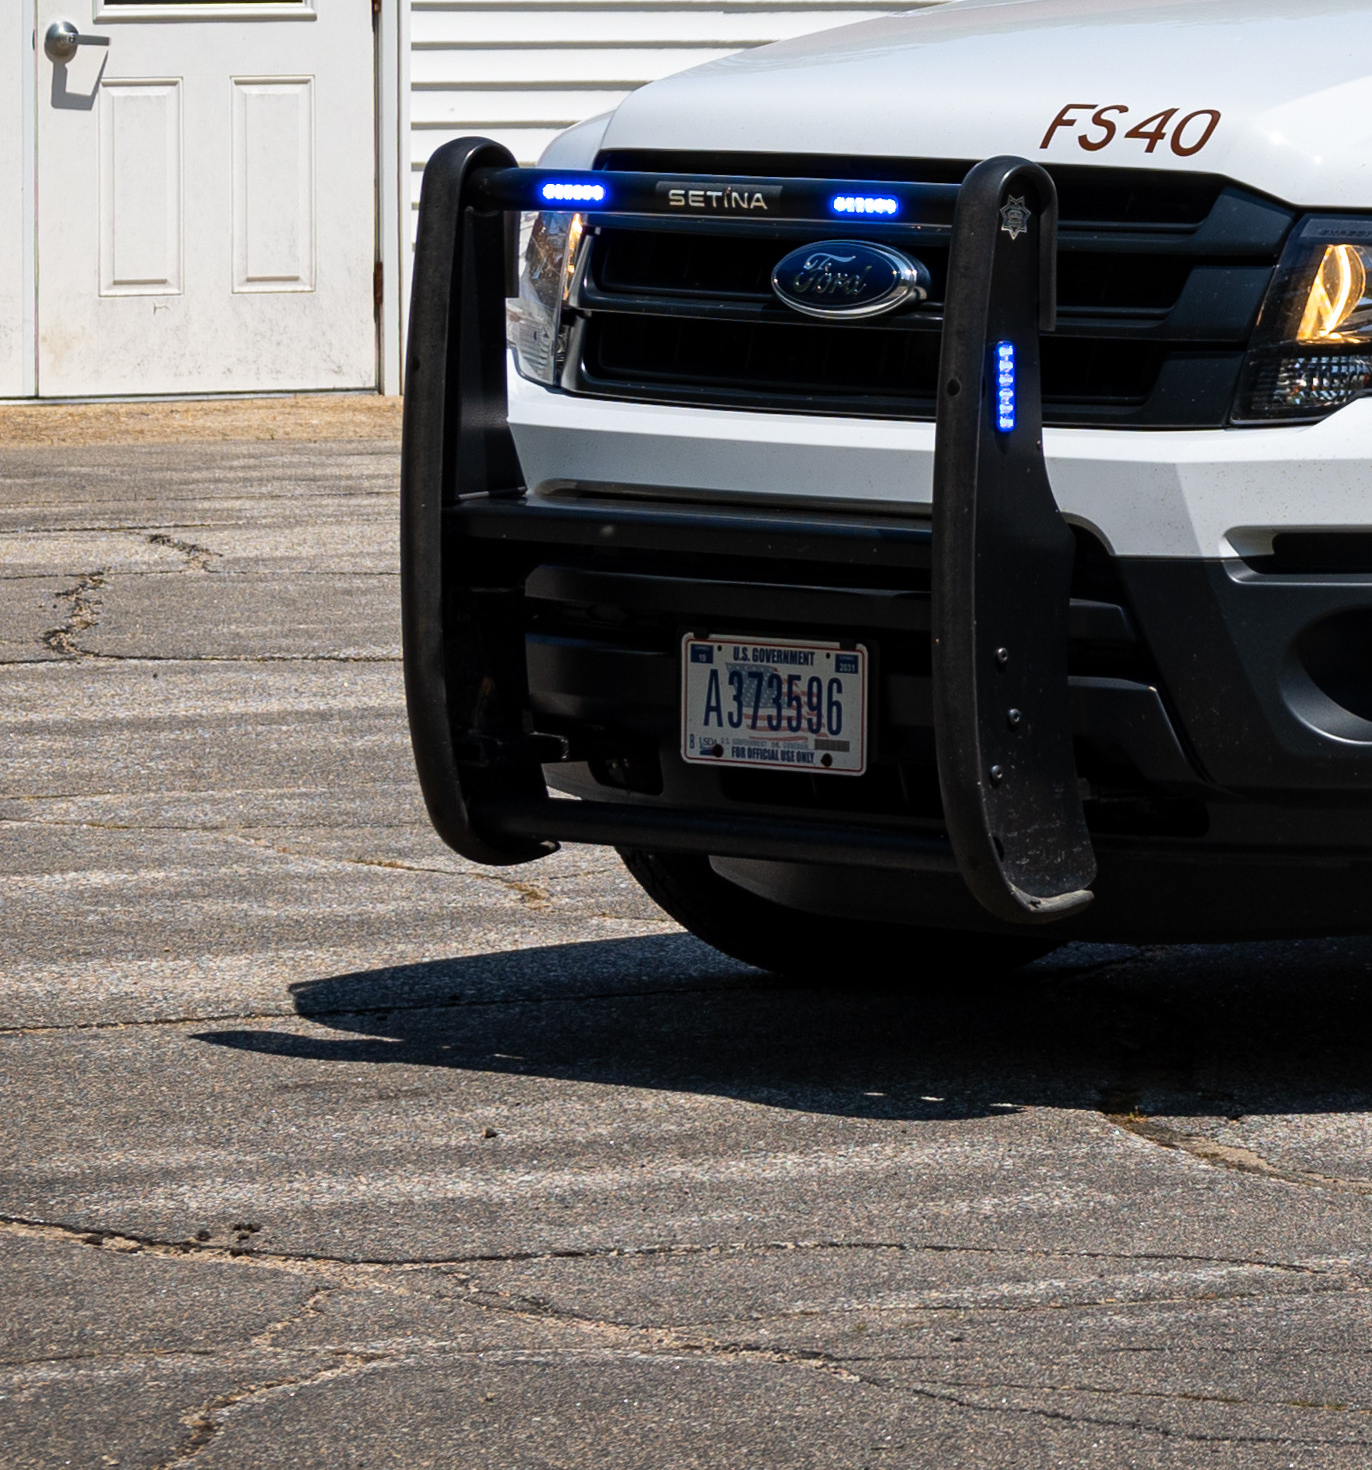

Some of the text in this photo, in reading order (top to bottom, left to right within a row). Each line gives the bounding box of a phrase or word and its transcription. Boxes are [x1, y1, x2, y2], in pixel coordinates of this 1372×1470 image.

[1039, 103, 1222, 157] FS40
[668, 186, 768, 210] SETINA
[793, 252, 873, 296] Ford
[733, 646, 816, 667] U.S. GOVERNMENT
[703, 668, 843, 736] A373596
[731, 746, 815, 764] FOR OFFICIAL USE ONLY
